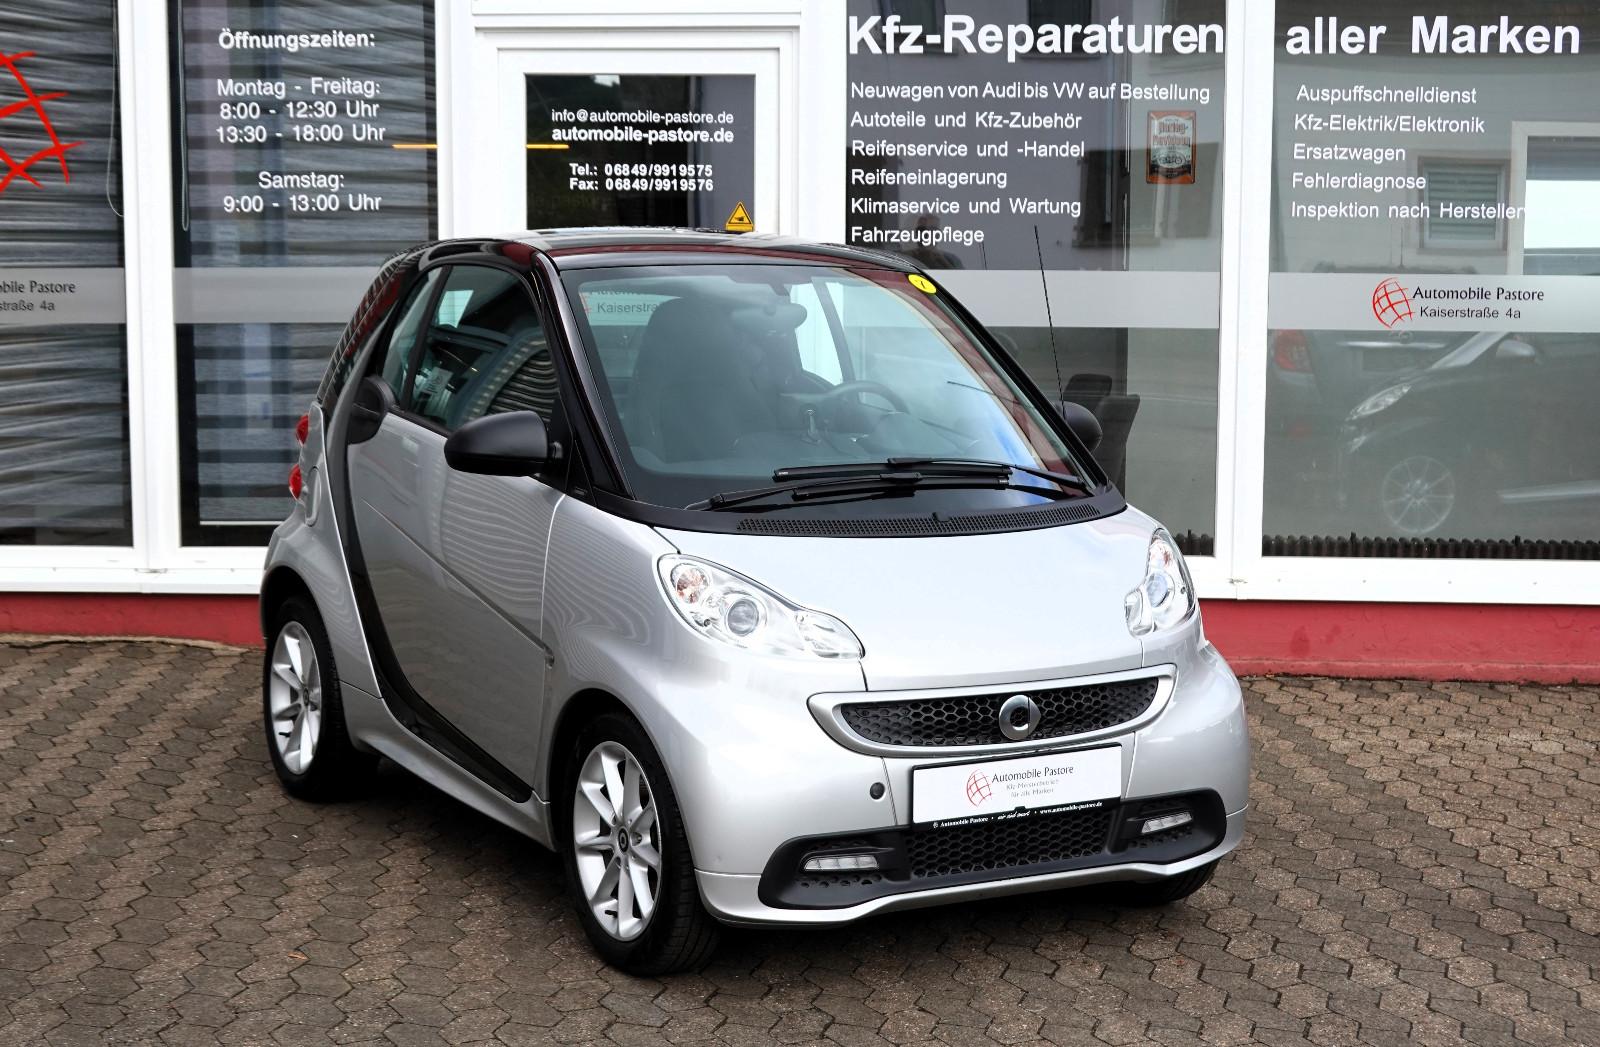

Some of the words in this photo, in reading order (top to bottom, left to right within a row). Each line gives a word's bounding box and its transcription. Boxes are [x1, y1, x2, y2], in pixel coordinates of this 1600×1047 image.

[218, 28, 376, 52] Öffnungszeiten:
[849, 14, 1225, 63] Kfz-Reparaturen
[1285, 16, 1386, 55] aller
[1411, 15, 1580, 54] Marken
[217, 78, 286, 99] Montag
[311, 77, 381, 98] Freitag:
[850, 82, 944, 100] Neuwagen
[948, 86, 978, 99] von
[982, 82, 1021, 99] Audi
[1024, 82, 1049, 99] bis
[1052, 82, 1085, 99] VW
[1088, 82, 1116, 99] auf
[1119, 83, 1210, 103] Bestellung
[1296, 84, 1477, 105] Auspuffschnelldienst
[219, 101, 261, 120] 8:00
[286, 101, 337, 119] 12:30
[346, 100, 380, 117] Uhr
[551, 108, 735, 126] info@automobile-pastore.de
[850, 111, 926, 129] Autoteile
[934, 111, 966, 128] und
[975, 111, 1083, 130] Kfz-Zubehör
[1294, 113, 1486, 133] Kfz-Elektrik/Elektronik
[216, 125, 267, 143] 13:30
[292, 124, 344, 142] 18:00
[352, 123, 387, 141] Uhr
[551, 126, 735, 145] automobile-pastore.de
[851, 140, 968, 157] Reifenservice
[977, 140, 1008, 157] und
[1017, 140, 1085, 158] -Handel
[1293, 143, 1406, 164] Ersatzwagen
[569, 163, 598, 177] Tel.:
[604, 163, 713, 177] 06849/9919575
[851, 168, 1008, 188] Reifeneinlagerung
[258, 171, 345, 192] Samstag:
[569, 177, 599, 191] Fax:
[605, 178, 714, 192] 06849/9919576
[1292, 172, 1427, 192] Fehlerdiagnose
[223, 195, 264, 213] 9:00
[289, 194, 340, 212] 13:00
[348, 193, 382, 211] Uhr
[851, 197, 960, 214] Klimaservice
[968, 197, 1001, 214] und
[1008, 197, 1082, 218] Wartung
[1291, 201, 1379, 221] Inspektion
[1388, 202, 1430, 219] nach
[851, 226, 985, 247] Fahrzeugpflege
[29, 280, 76, 293] Pastore
[1413, 286, 1492, 301] Automobile
[1496, 287, 1545, 301] Pastore
[39, 300, 55, 311] 4a
[597, 302, 660, 313] Kaiserstra
[1420, 306, 1500, 319] Kaiserstraße
[1505, 307, 1522, 319] 4a
[992, 768, 1042, 784] Automobile
[1044, 766, 1074, 777] Pastore
